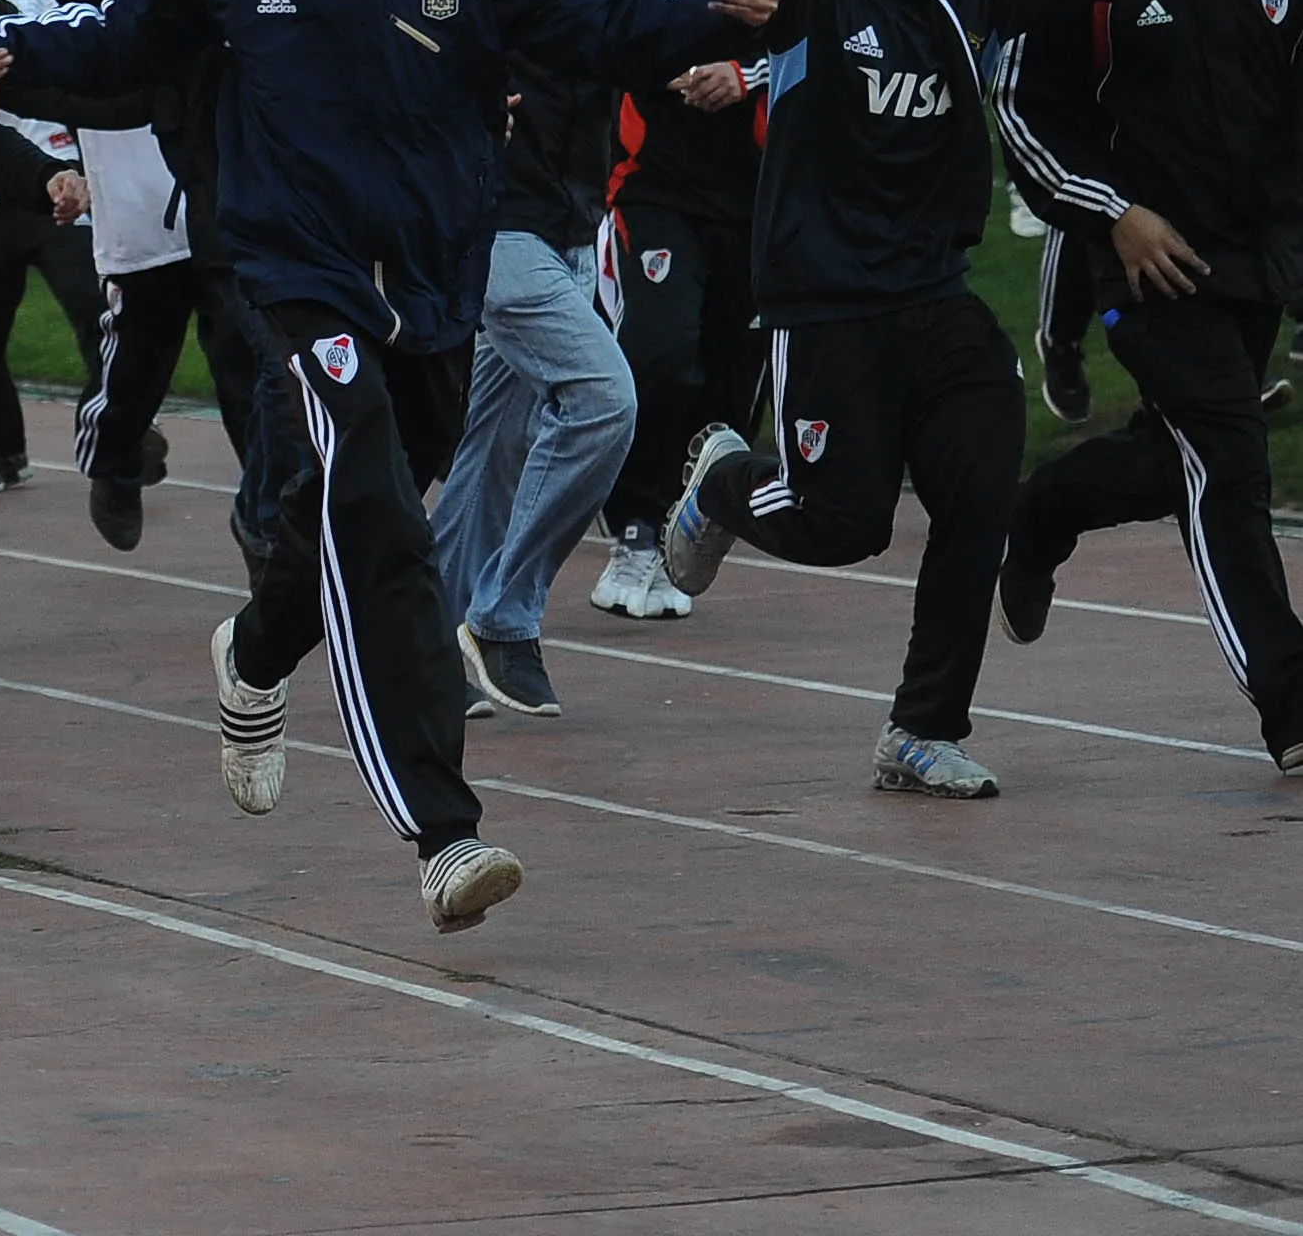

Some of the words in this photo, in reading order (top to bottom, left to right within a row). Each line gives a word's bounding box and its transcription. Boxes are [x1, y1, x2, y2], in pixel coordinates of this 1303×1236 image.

[256, 4, 298, 14] adidas
[1136, 14, 1174, 27] adidas
[843, 40, 884, 59] adidas
